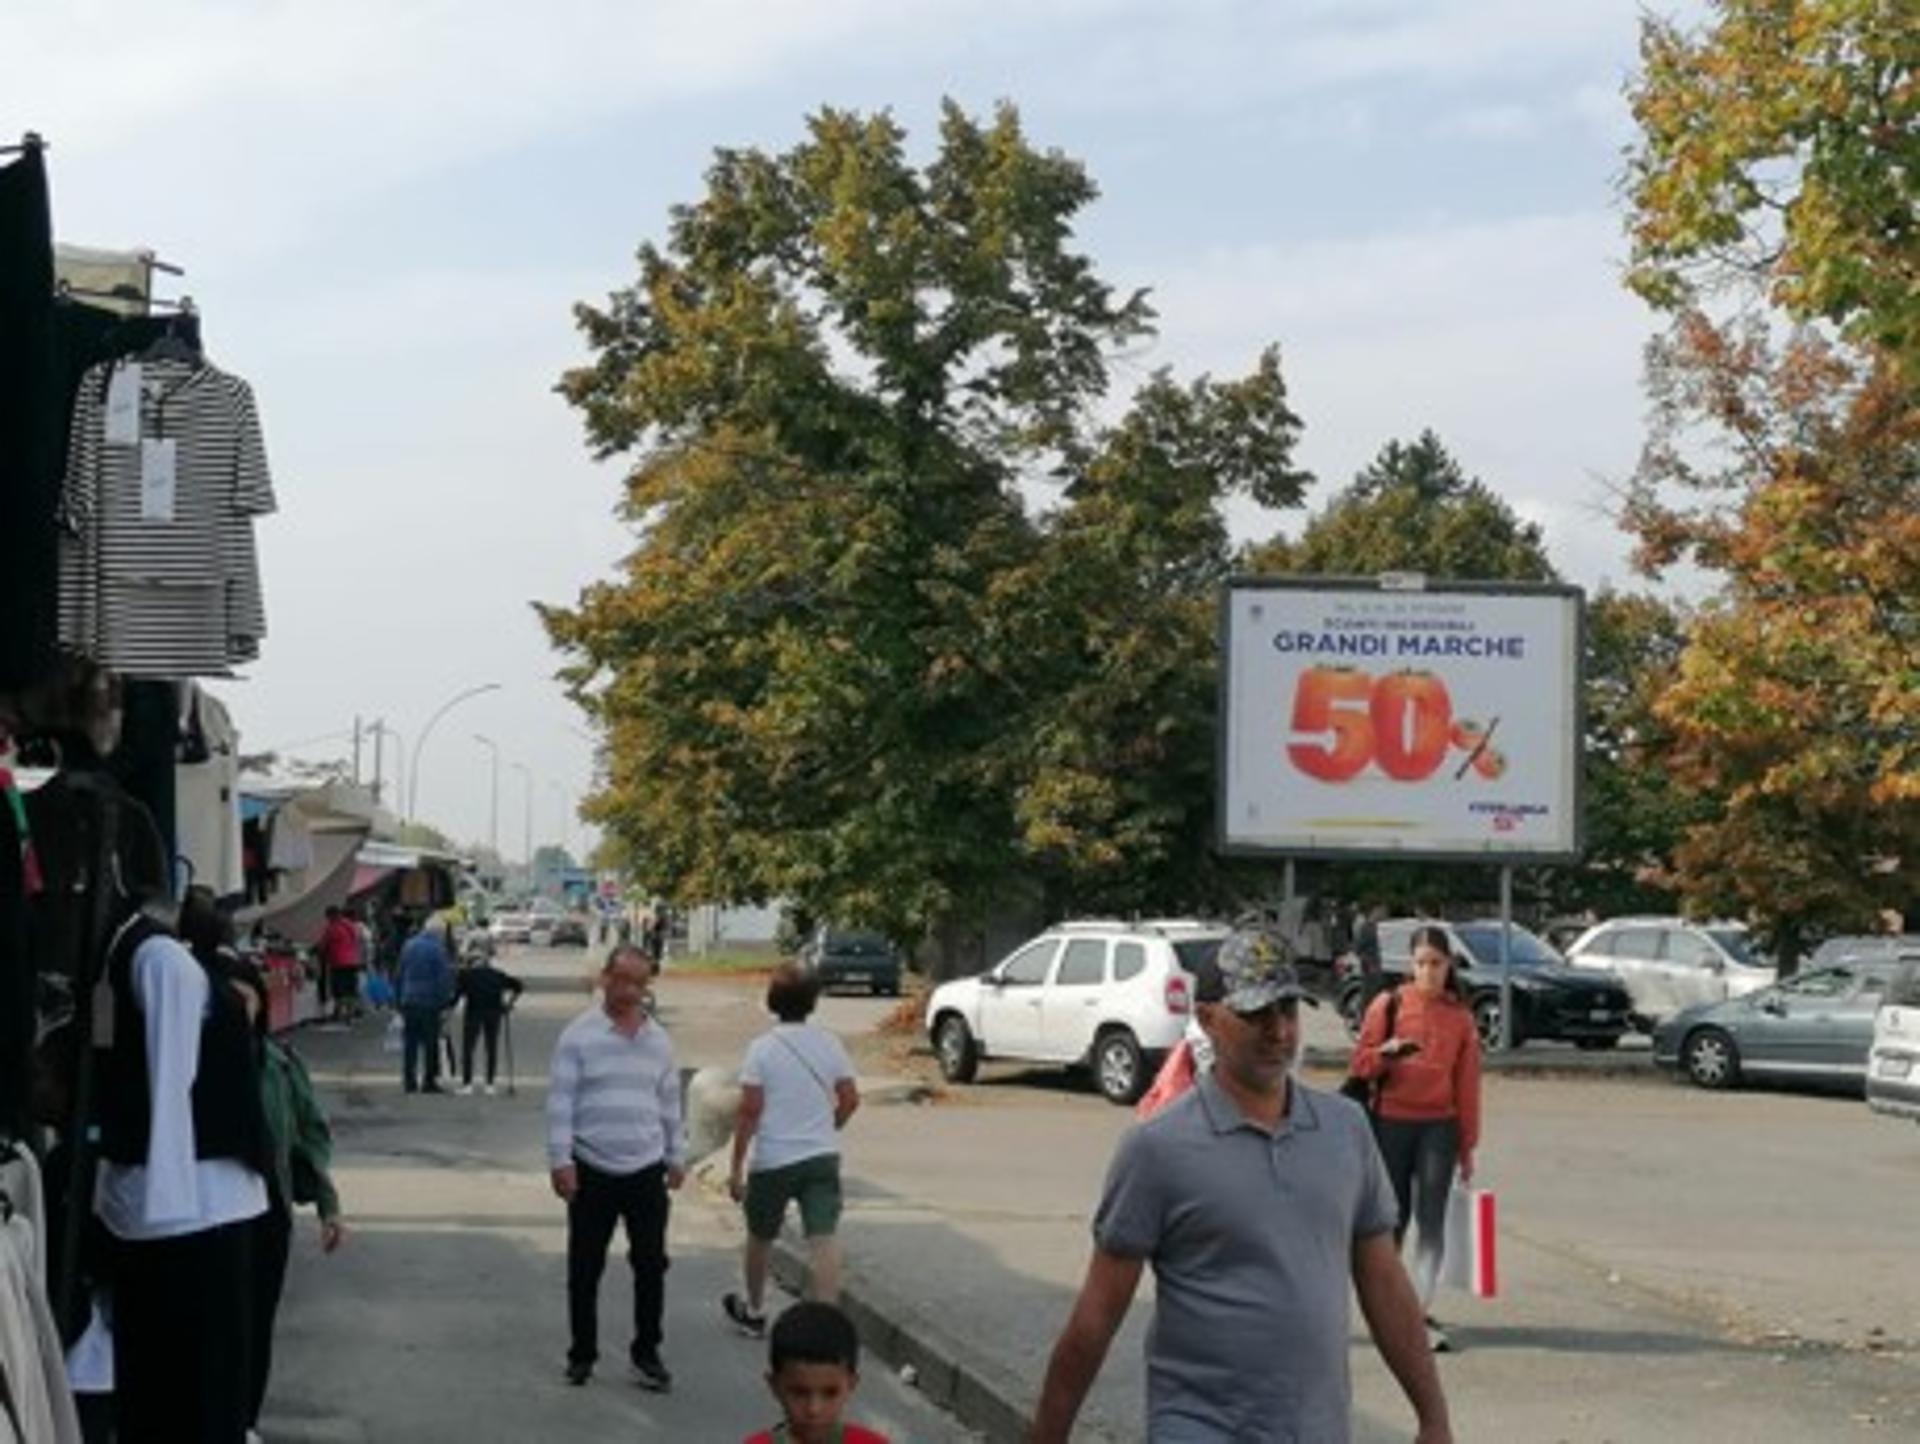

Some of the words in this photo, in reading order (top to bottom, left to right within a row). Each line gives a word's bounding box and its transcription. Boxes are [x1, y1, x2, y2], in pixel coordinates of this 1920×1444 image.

[1273, 631, 1387, 655] GRANDI
[1397, 634, 1525, 658] MARCHE
[1286, 664, 1507, 784] 50%
